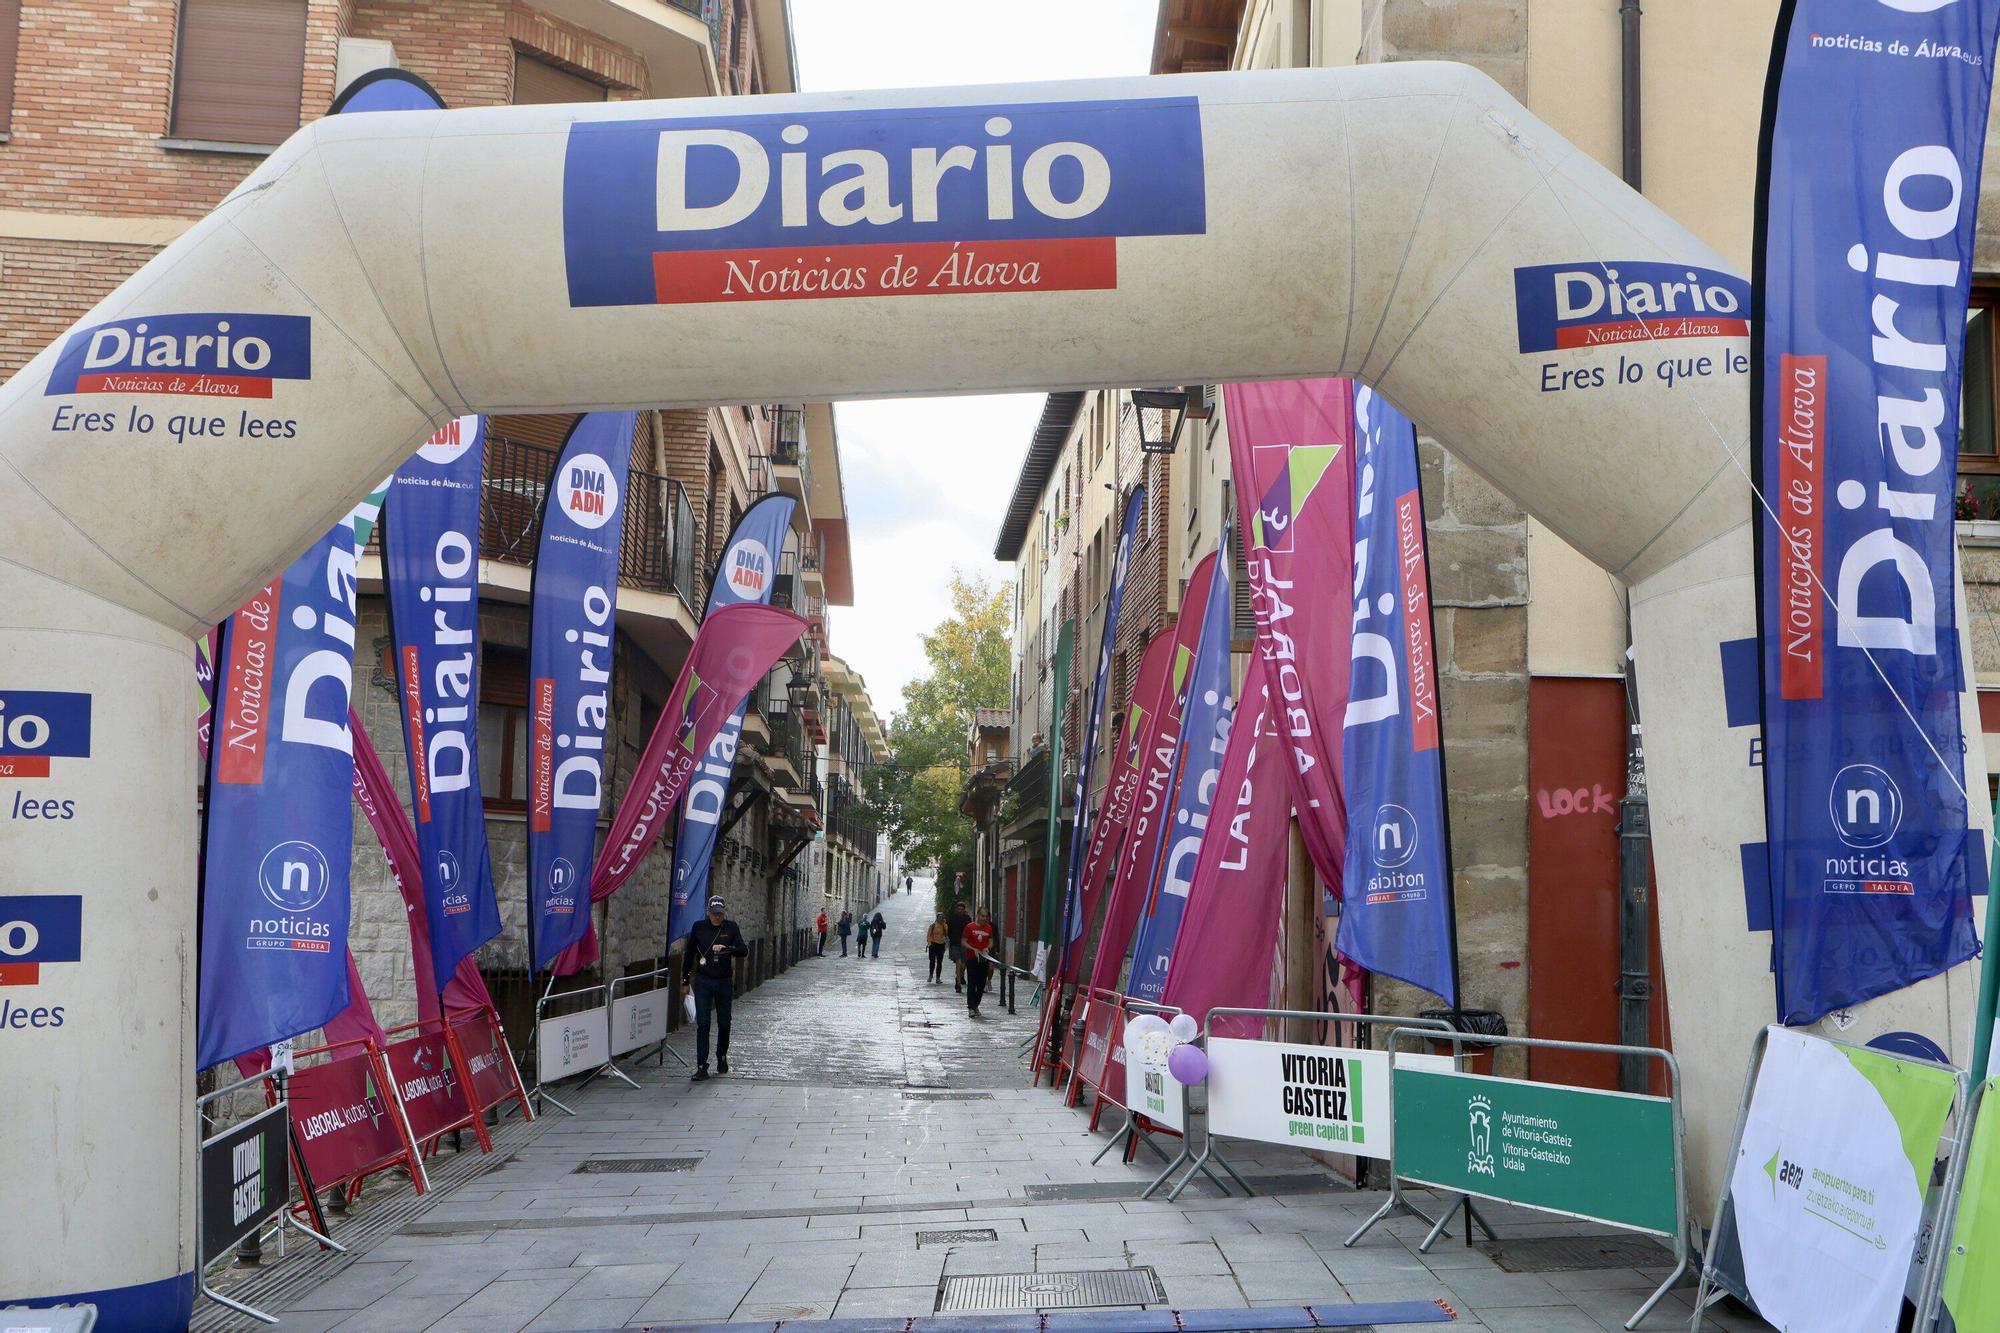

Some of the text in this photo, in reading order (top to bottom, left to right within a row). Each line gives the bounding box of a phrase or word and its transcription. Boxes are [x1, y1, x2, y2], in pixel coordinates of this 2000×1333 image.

[1812, 33, 1882, 53] noticias
[1888, 40, 1909, 56] de
[656, 116, 1111, 232] Diario
[722, 242, 1041, 296] Noticias de Álava
[1554, 268, 1738, 321] Diario
[83, 320, 272, 372] Diario
[1586, 318, 1719, 345] Noticias de Álava
[102, 373, 240, 395] Noticias de Álava
[1541, 347, 1748, 392] Eres lo que le
[1836, 144, 1963, 655] Diario
[52, 403, 297, 443] Eres lo que lees
[398, 476, 430, 486] noticias
[431, 478, 441, 487] de
[570, 467, 605, 494] DNA
[570, 490, 604, 516] ADN
[1779, 367, 1816, 663] Noticias de Álava
[550, 534, 578, 545] noticias
[579, 539, 587, 547] de
[736, 549, 764, 573] DNA
[732, 567, 764, 590] ADN
[282, 546, 356, 757] Dia
[420, 530, 473, 794] Diario
[228, 599, 270, 754] Noticias de
[554, 585, 612, 809] Diario
[407, 652, 428, 803] Noticias de Álava
[534, 683, 553, 816] Noticias de Álava
[685, 714, 742, 825] Dia
[11, 790, 76, 820] lees
[1826, 853, 1909, 877] noticias
[1872, 883, 1909, 892] TALDEA
[250, 915, 330, 937] noticias
[256, 939, 326, 950] GRUPO TALDEA
[1140, 982, 1164, 994] notic
[0, 1000, 65, 1028] lees
[1281, 1053, 1347, 1088] VITORIA
[400, 1076, 431, 1102] LABORAL
[1283, 1085, 1348, 1121] GASTEIZ
[301, 1103, 368, 1141] LABORAL kutxa
[1288, 1119, 1349, 1142] green capital
[1501, 1110, 1558, 1131] Ayuntamiento
[1502, 1125, 1573, 1148] de Vitoria-Gasteiz
[232, 1133, 261, 1185] VITORIA
[1502, 1142, 1571, 1166] Vitoria-Gasteizko
[1502, 1158, 1526, 1172] Udala
[1779, 1159, 1804, 1191] aena
[233, 1173, 261, 1227] GASTEIZ
